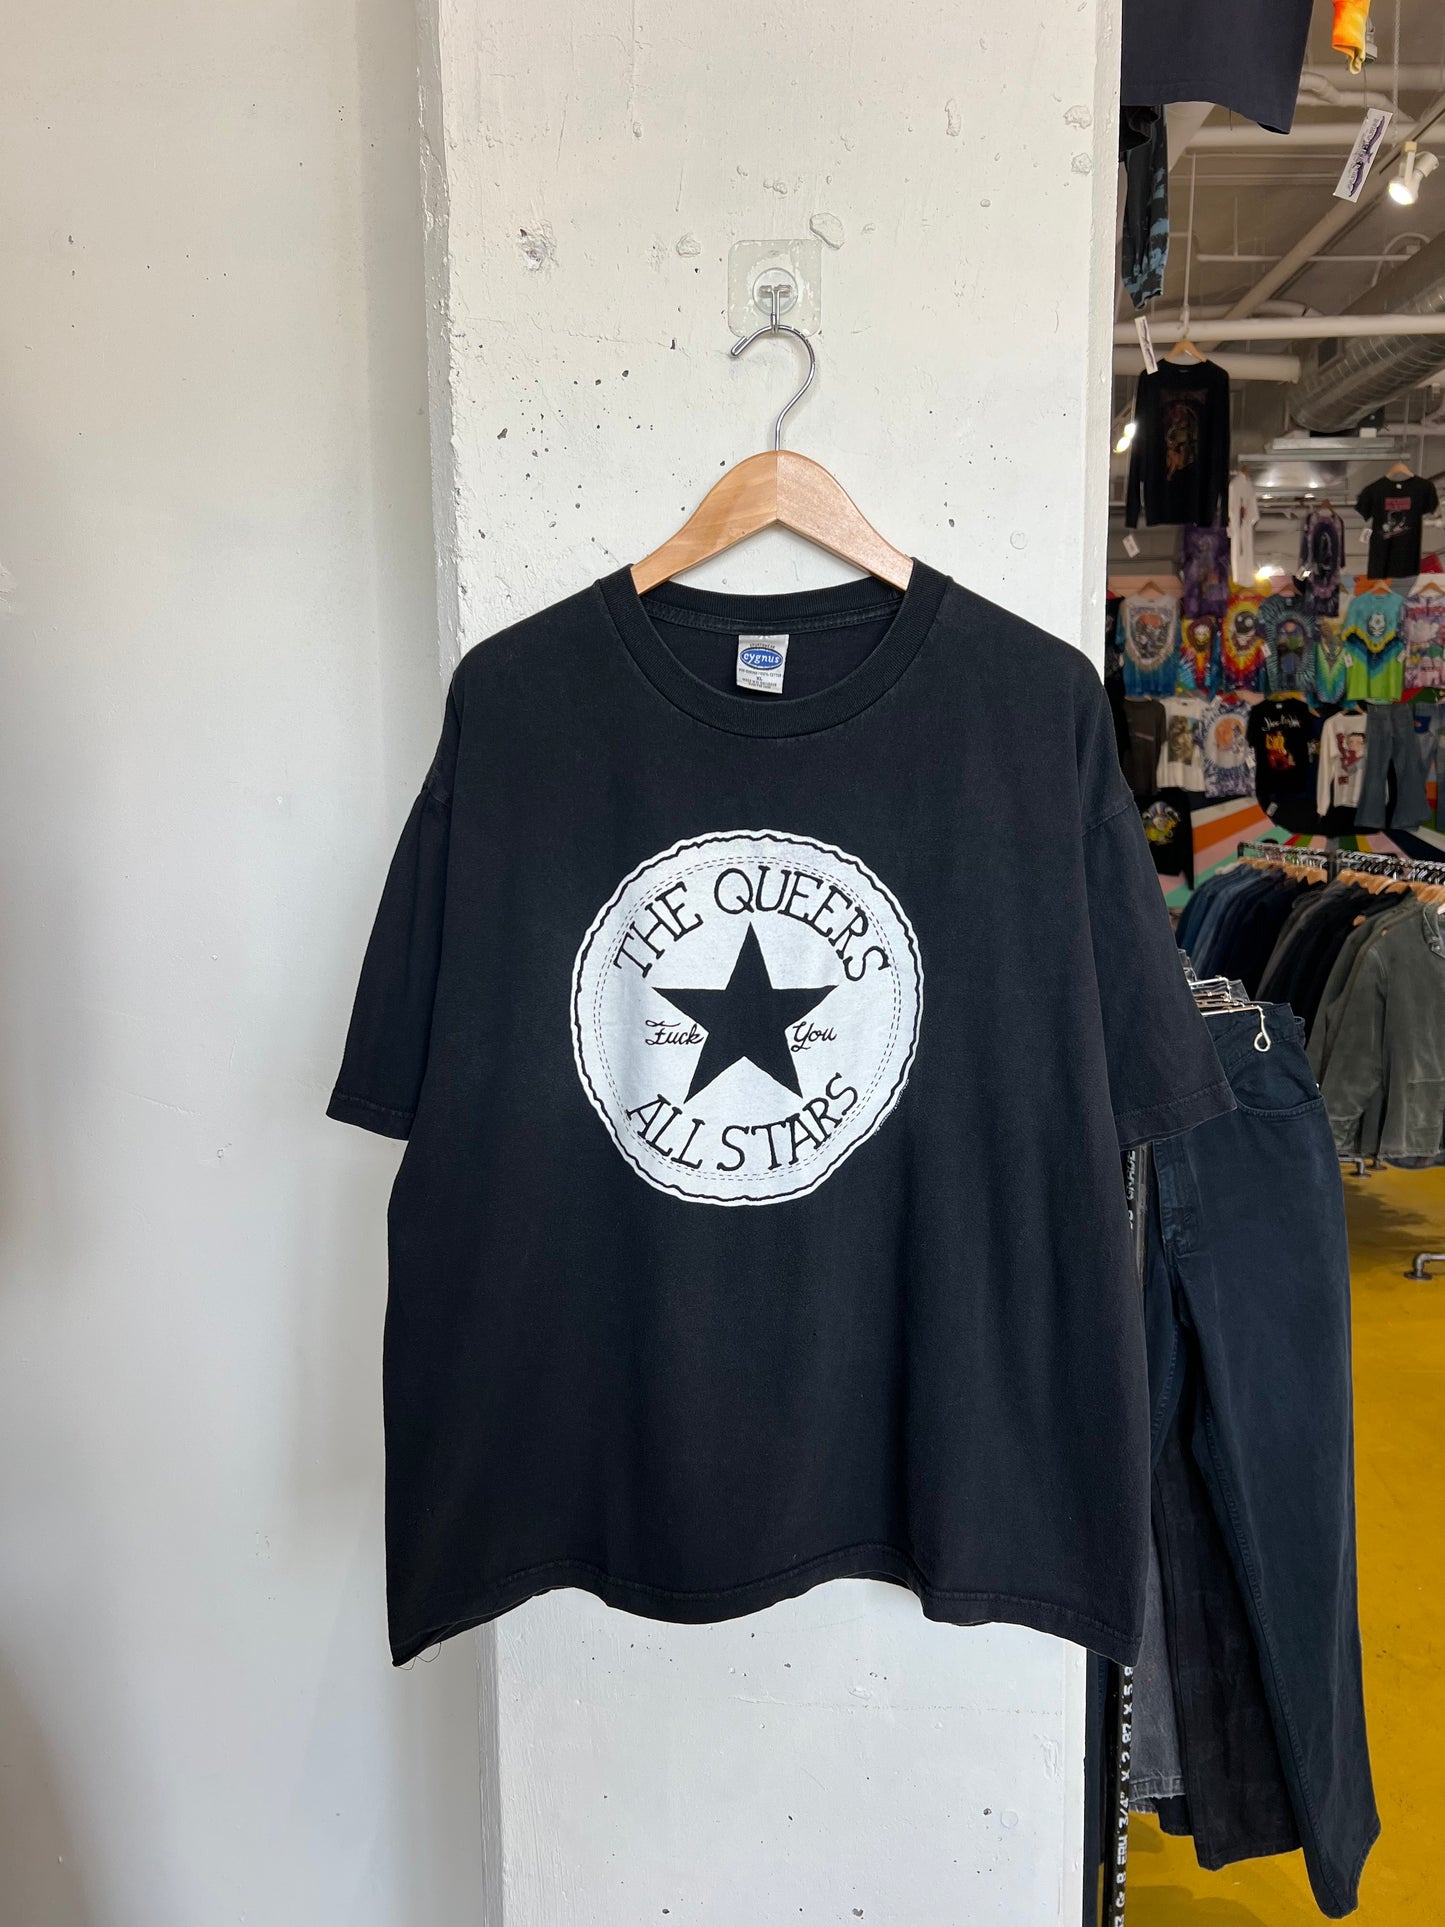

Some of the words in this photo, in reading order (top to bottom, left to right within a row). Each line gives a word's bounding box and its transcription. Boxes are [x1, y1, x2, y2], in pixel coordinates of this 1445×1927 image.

[743, 652, 780, 664] cygnus
[613, 881, 704, 978] THE
[714, 866, 891, 982] QUEERS
[645, 1020, 704, 1046] Fuck
[790, 1020, 838, 1053] You
[626, 1094, 706, 1170] ALL
[716, 1072, 859, 1172] STARS
